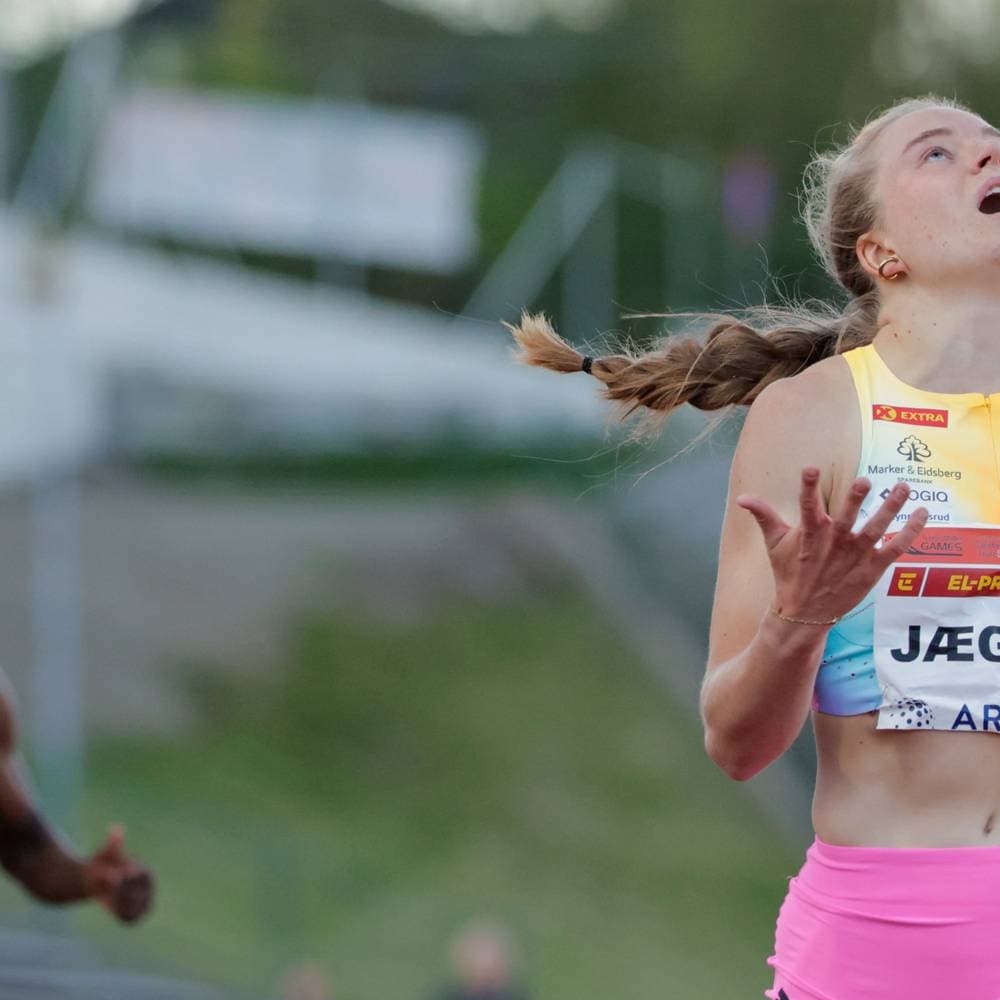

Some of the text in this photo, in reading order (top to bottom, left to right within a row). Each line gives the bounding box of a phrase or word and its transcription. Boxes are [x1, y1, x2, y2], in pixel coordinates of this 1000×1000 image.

[901, 411, 945, 423] EXTRA
[868, 464, 962, 480] Marker & Eidsberg
[908, 489, 949, 502] OGIQ
[920, 542, 963, 551] GAMES
